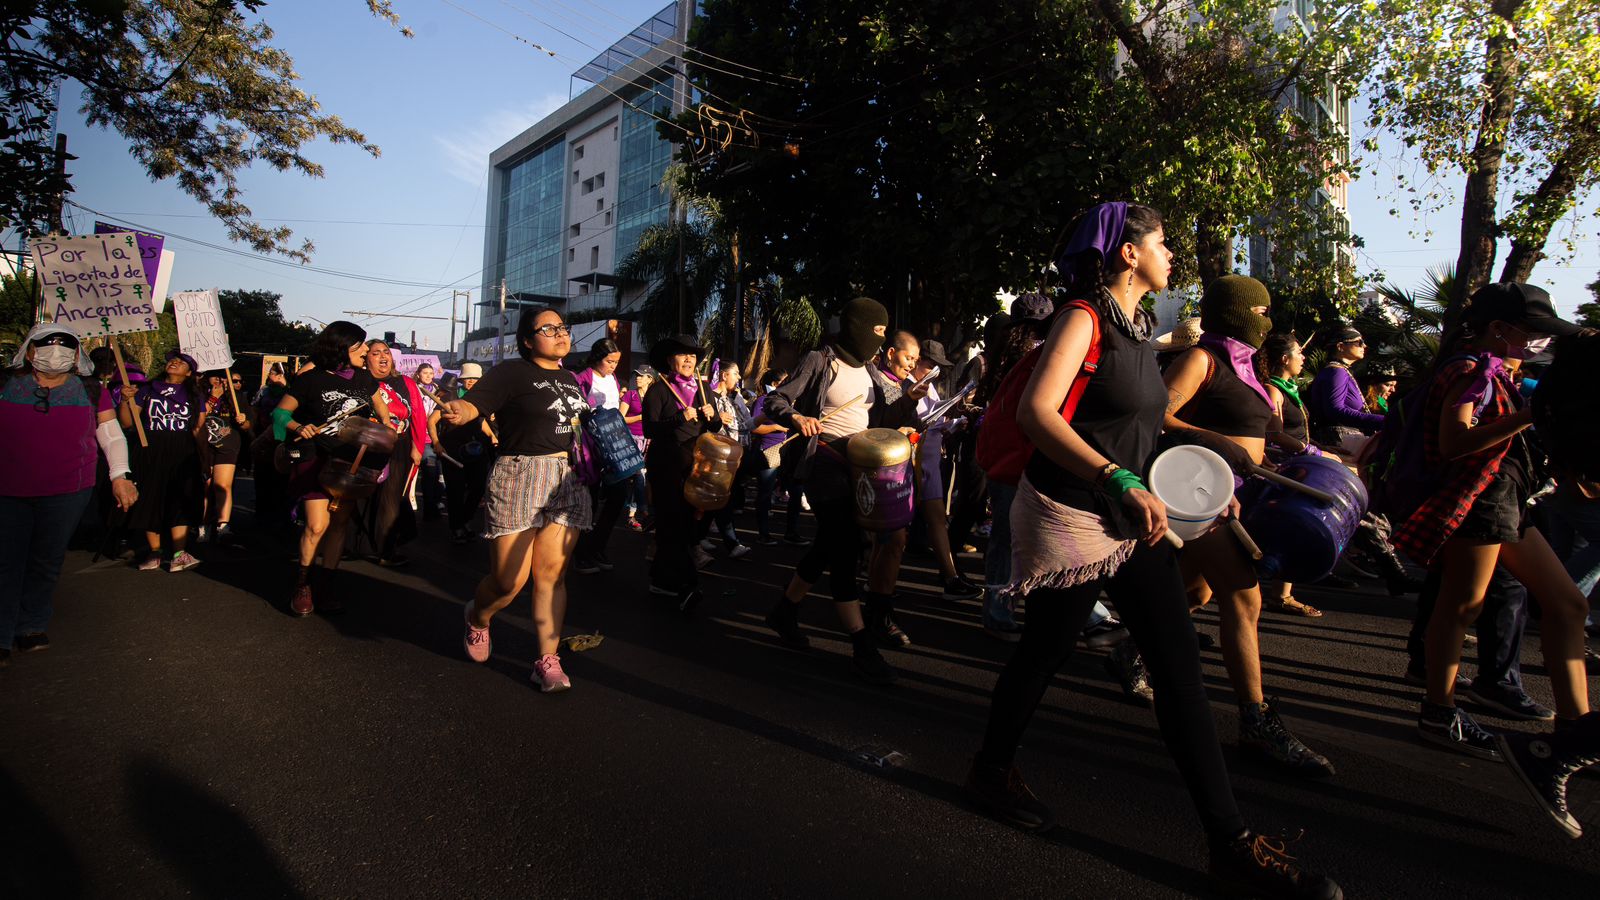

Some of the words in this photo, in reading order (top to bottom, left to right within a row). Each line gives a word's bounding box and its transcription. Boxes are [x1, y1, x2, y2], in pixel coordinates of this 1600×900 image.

[33, 242, 86, 267] Por
[102, 240, 130, 261] la
[41, 265, 120, 286] Libertad
[124, 265, 142, 278] de
[54, 300, 152, 323] Ancentras
[185, 312, 216, 328] GRITO
[188, 331, 209, 349] LAS
